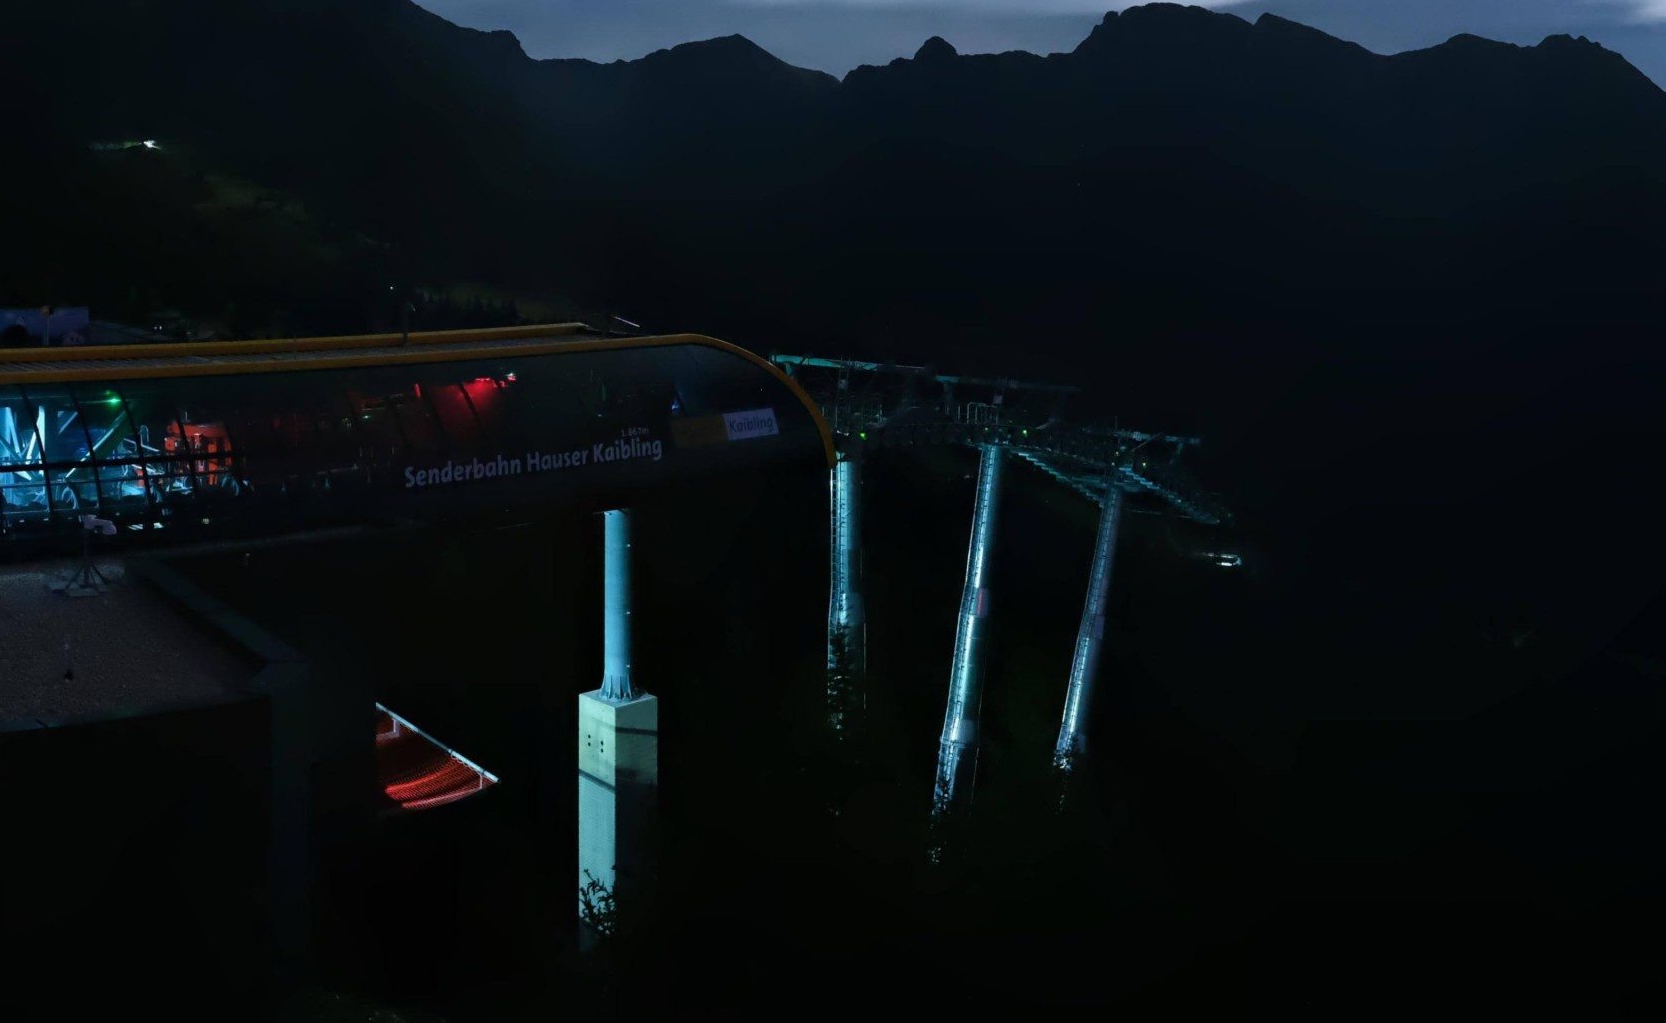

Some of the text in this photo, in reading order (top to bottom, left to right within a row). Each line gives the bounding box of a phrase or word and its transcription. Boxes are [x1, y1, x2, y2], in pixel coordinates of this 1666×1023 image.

[728, 416, 774, 433] Kaibling
[404, 436, 663, 489] Senderbahn Hauser Kaibling
